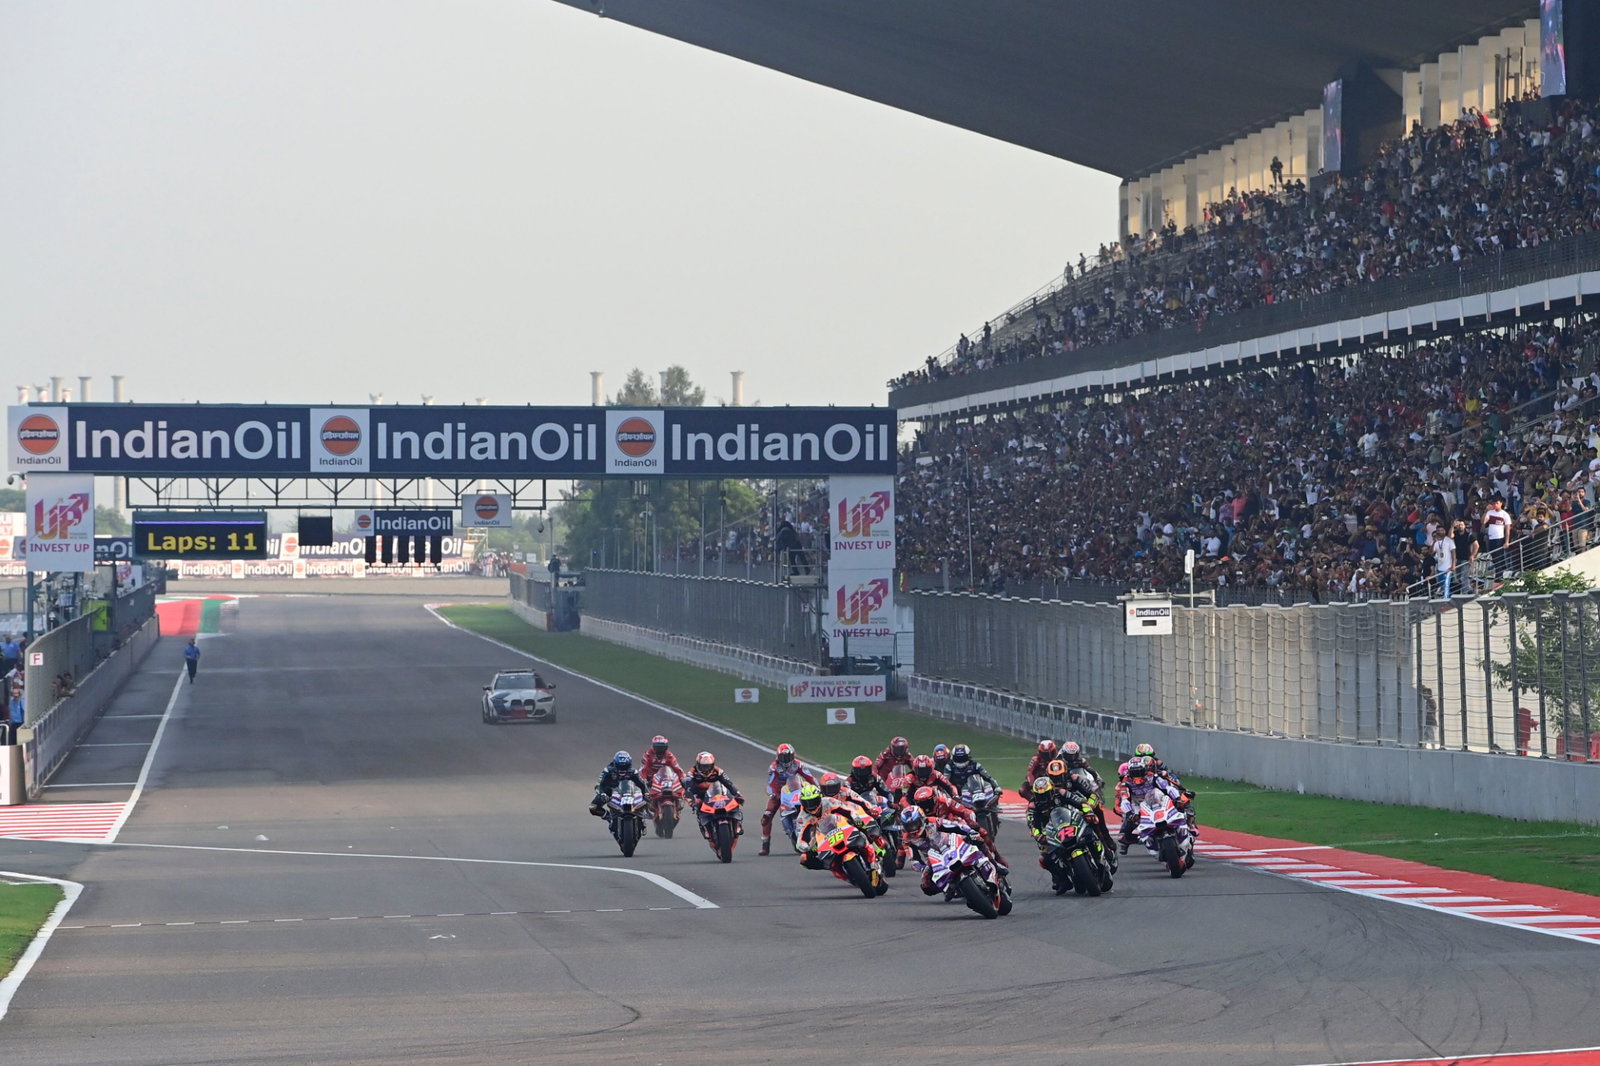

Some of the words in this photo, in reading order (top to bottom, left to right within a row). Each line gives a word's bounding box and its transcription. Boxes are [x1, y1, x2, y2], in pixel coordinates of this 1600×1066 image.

[76, 420, 301, 459] IndianOil
[377, 422, 597, 461] IndianOil
[672, 423, 888, 462] IndianOil
[17, 456, 61, 464] IndianOil
[319, 457, 363, 465] IndianOil
[614, 459, 657, 467] IndianOil
[375, 516, 451, 530] IndianOil
[30, 543, 71, 553] INVEST
[74, 543, 90, 553] UP
[148, 532, 216, 552] Laps:
[227, 532, 257, 550] 11
[834, 541, 873, 550] INVEST
[876, 541, 892, 550] UP
[183, 564, 232, 576] IndianOil
[245, 563, 293, 575] IndianOil
[33, 653, 41, 665] F
[811, 686, 861, 697] INVEST
[864, 685, 883, 697] UP
[828, 831, 845, 847] 36
